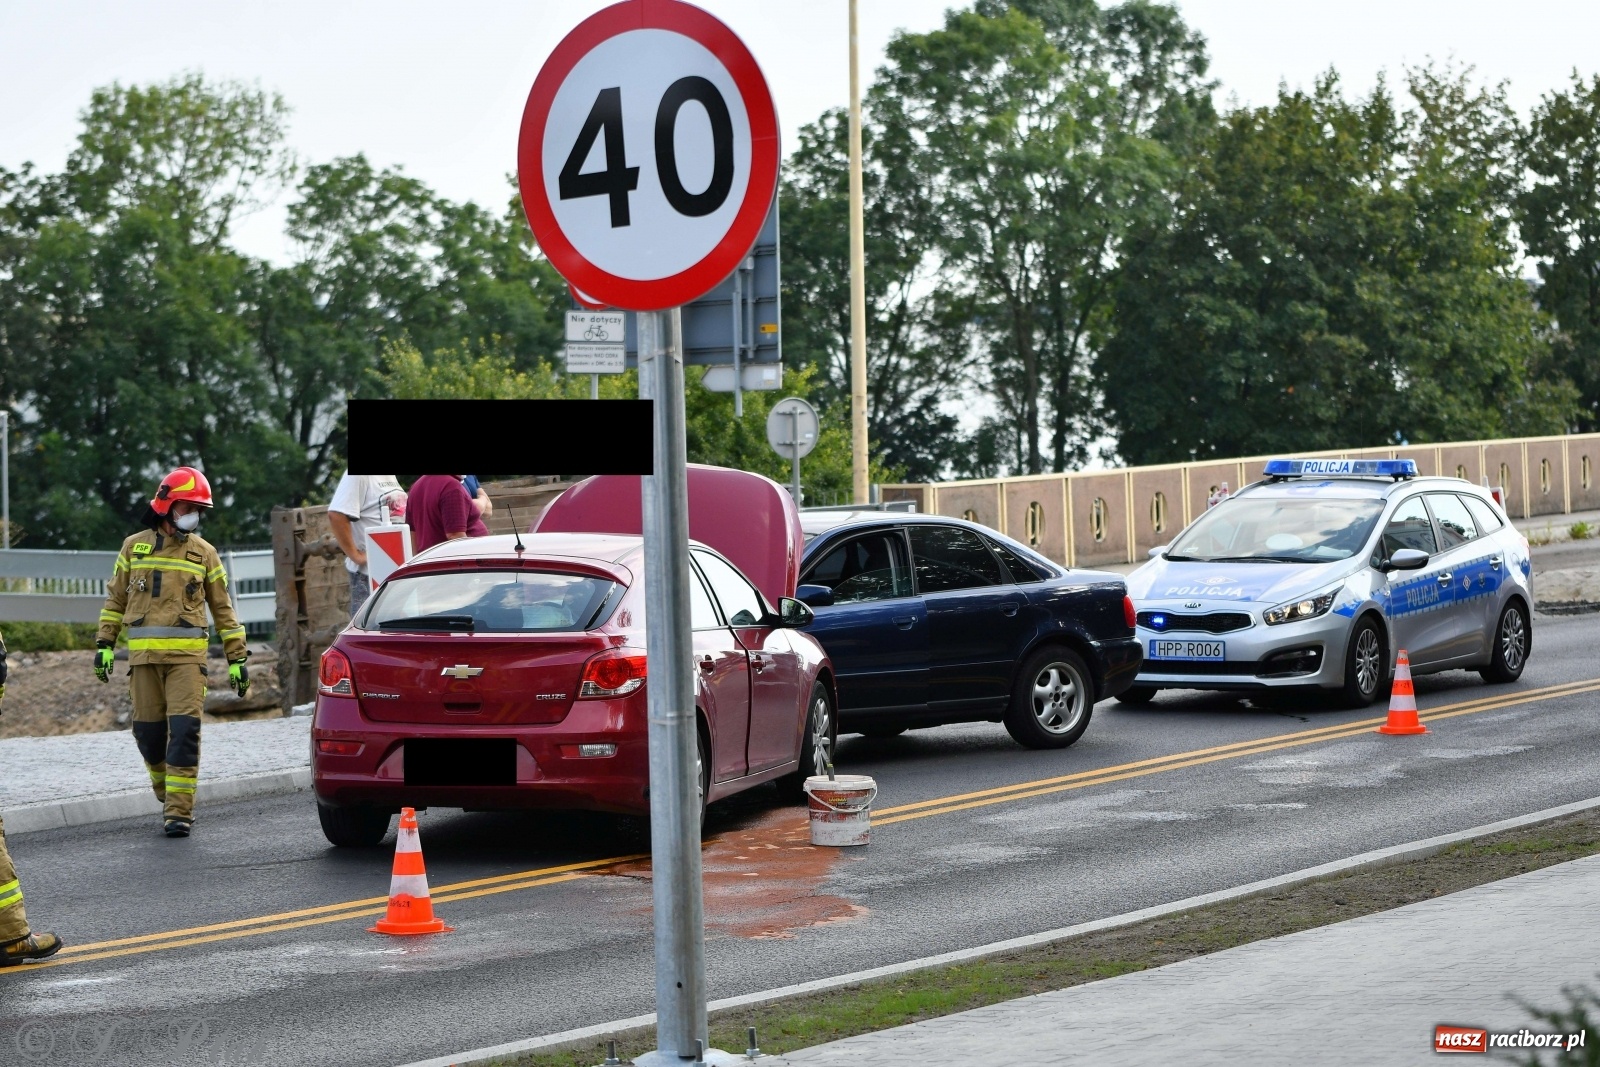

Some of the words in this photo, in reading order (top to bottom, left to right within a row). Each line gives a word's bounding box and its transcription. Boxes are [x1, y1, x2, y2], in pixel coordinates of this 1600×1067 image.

[558, 75, 734, 228] 40
[571, 315, 585, 323] Nie
[590, 315, 622, 325] dotyczy
[1303, 461, 1349, 473] POLICJA
[135, 544, 149, 552] PSP
[1165, 586, 1243, 597] POLICJA
[1405, 583, 1440, 608] POLICJA
[1158, 642, 1182, 657] HPP
[1187, 643, 1220, 657] R006
[362, 692, 400, 700] CHEVROLET
